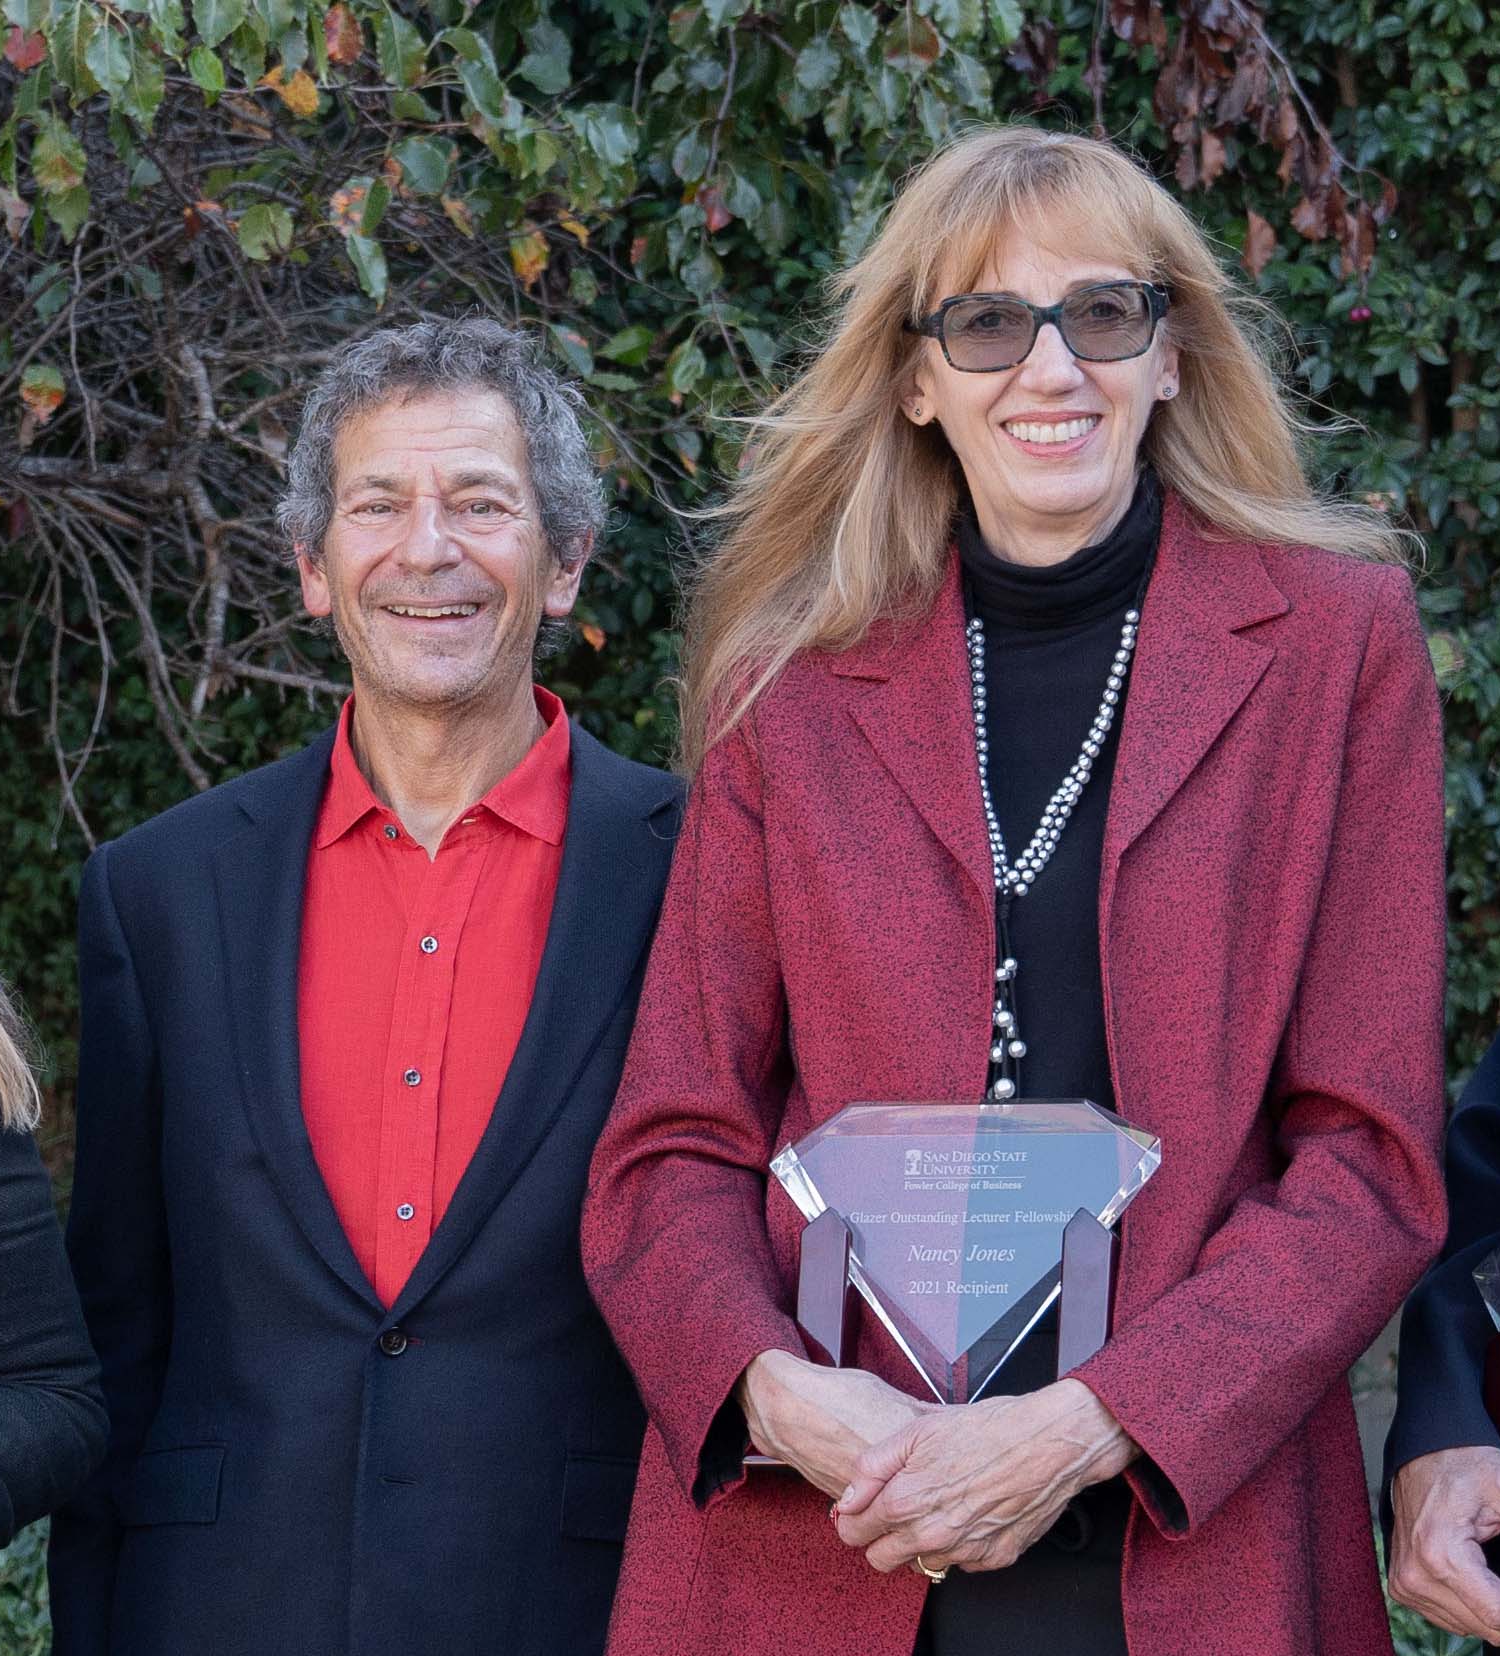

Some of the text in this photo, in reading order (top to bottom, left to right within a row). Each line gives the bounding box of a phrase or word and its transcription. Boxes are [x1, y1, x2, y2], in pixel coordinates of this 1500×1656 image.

[923, 1150, 1028, 1163] SAN DIEGO STATE
[923, 1163, 999, 1176] UNIVERSITY
[904, 1180, 1022, 1192] Fowler College of Business
[849, 1211, 887, 1224] Glazer
[890, 1210, 959, 1226] Outstanding
[962, 1210, 1011, 1223] Lecturer
[907, 1244, 1016, 1266] Nancy Jones
[909, 1280, 1009, 1297] 2021 Recipient
